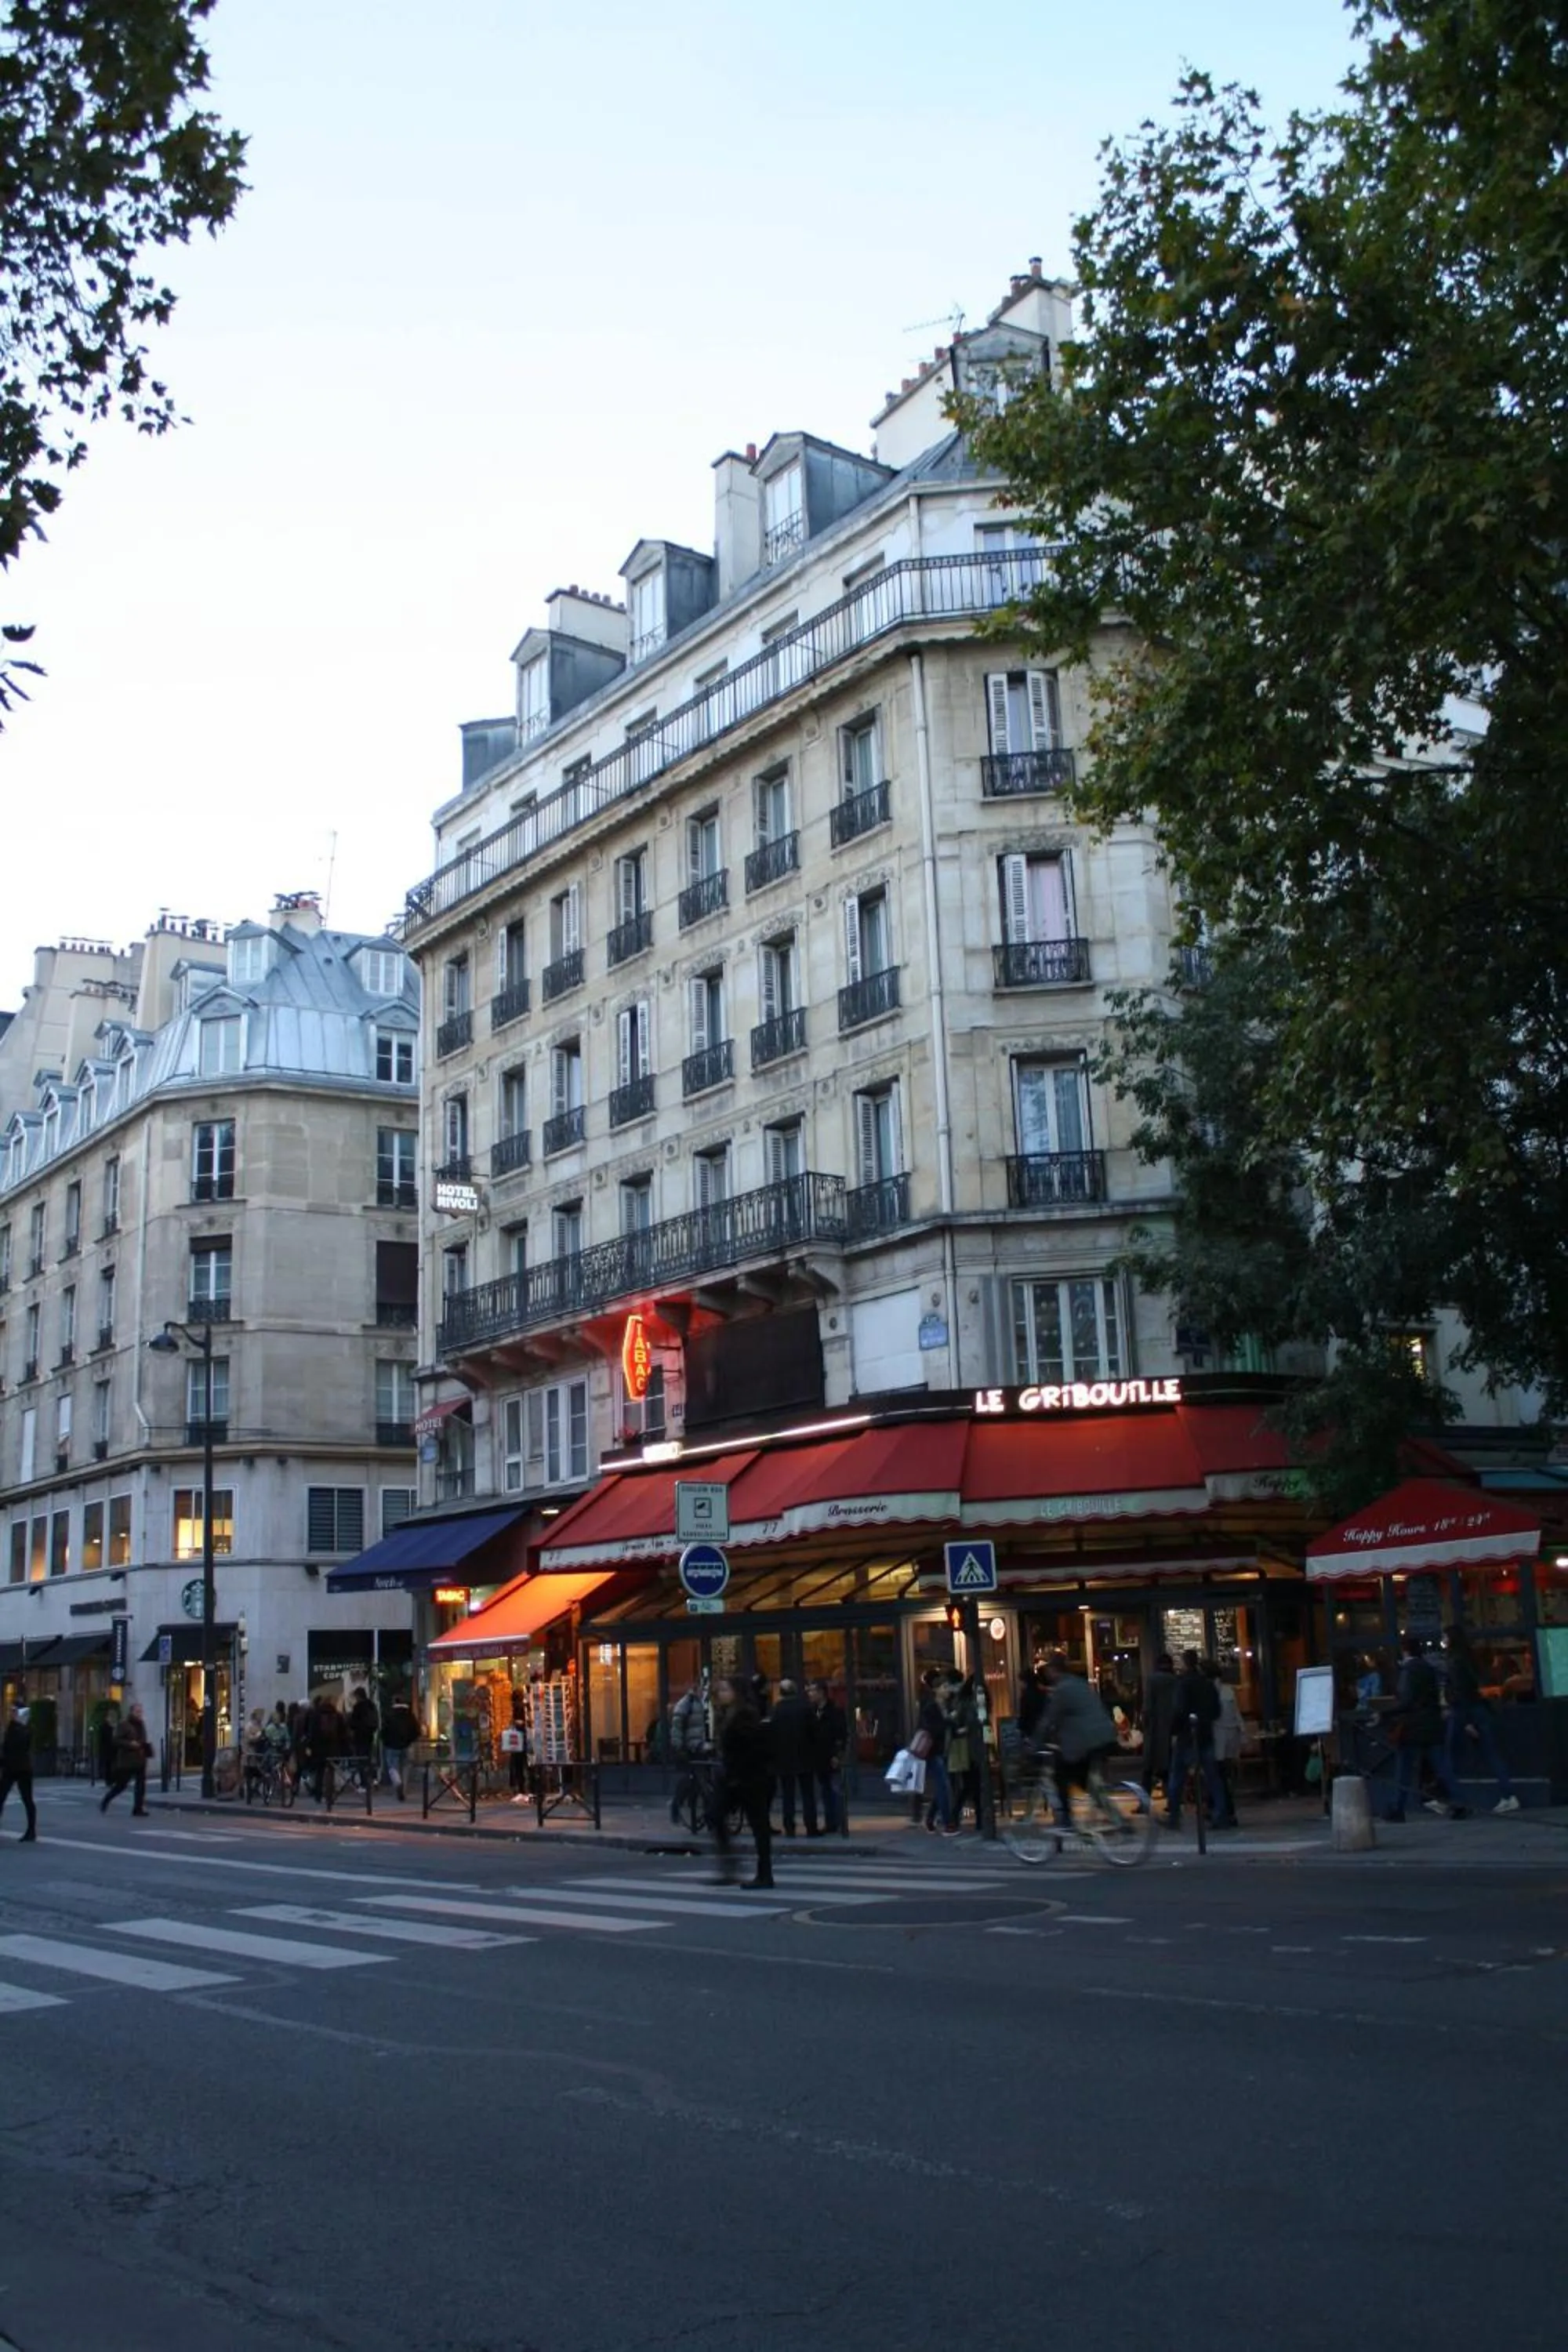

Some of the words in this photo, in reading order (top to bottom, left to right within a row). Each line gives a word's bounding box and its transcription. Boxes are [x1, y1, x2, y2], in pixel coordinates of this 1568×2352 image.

[437, 1183, 477, 1198] HOTEL
[437, 1196, 477, 1210] RIVOLI
[633, 1323, 648, 1391] TABAC
[975, 1389, 1004, 1412] LE
[828, 1500, 887, 1517] Brasserie
[1343, 1528, 1383, 1544] Happy
